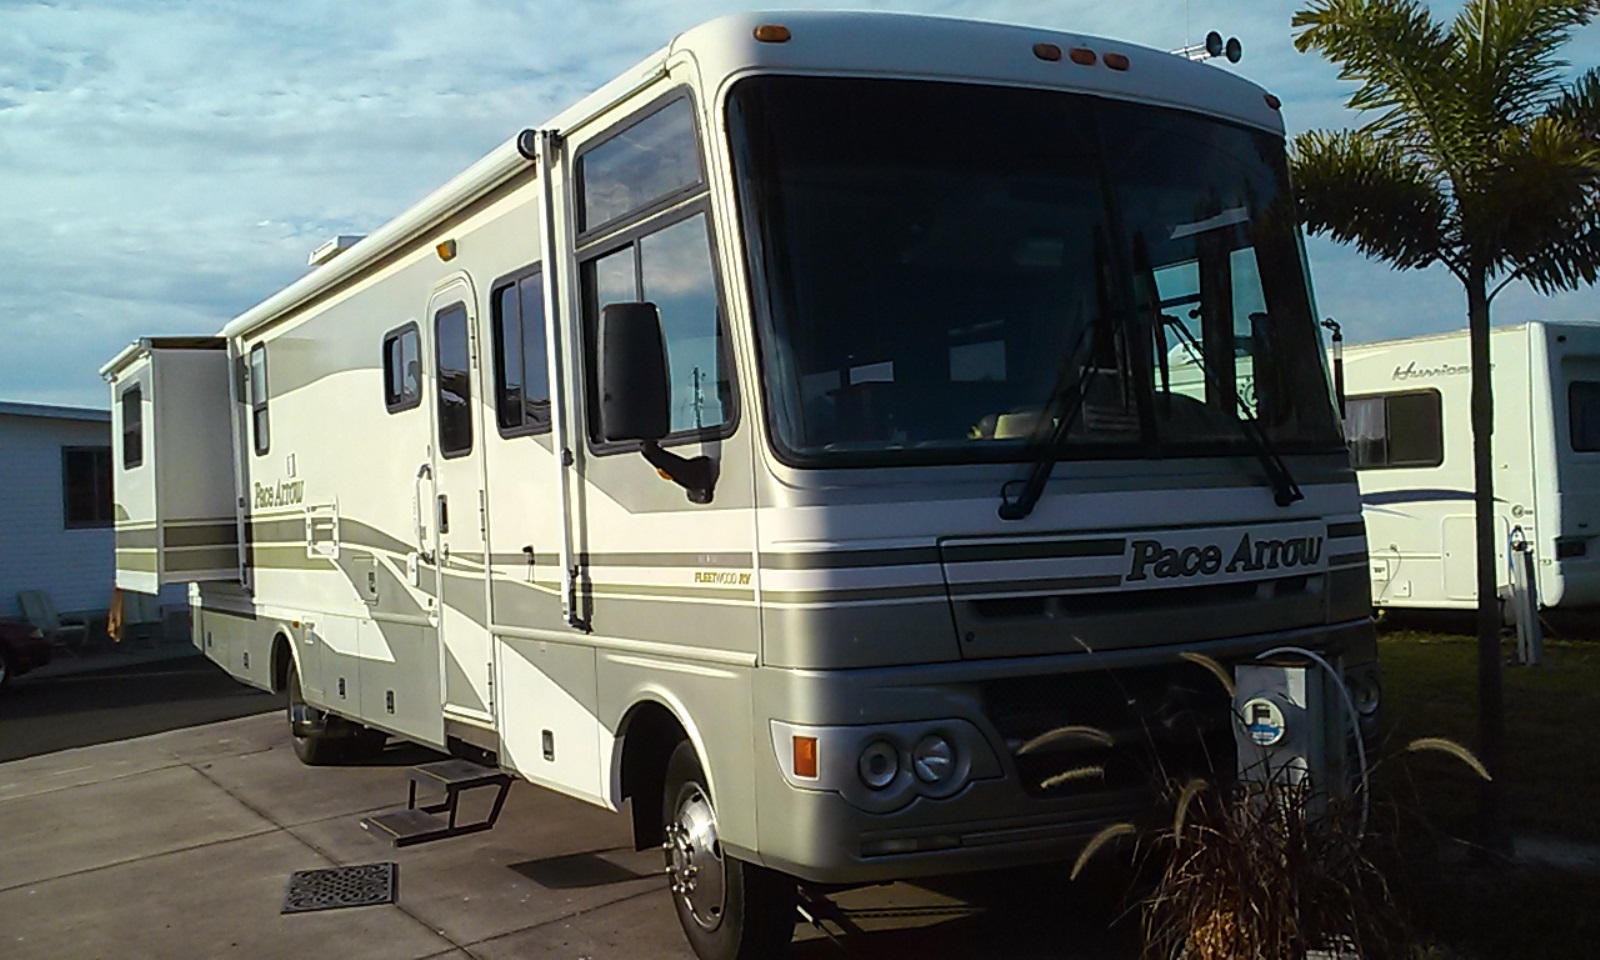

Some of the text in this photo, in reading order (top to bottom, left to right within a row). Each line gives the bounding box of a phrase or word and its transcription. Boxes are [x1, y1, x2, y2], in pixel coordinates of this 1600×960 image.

[1392, 361, 1496, 381] Hurrica
[254, 478, 304, 509] Pace Arrow
[1126, 533, 1323, 581] Pace Arrow
[695, 572, 751, 585] FLEETWOOD RV
